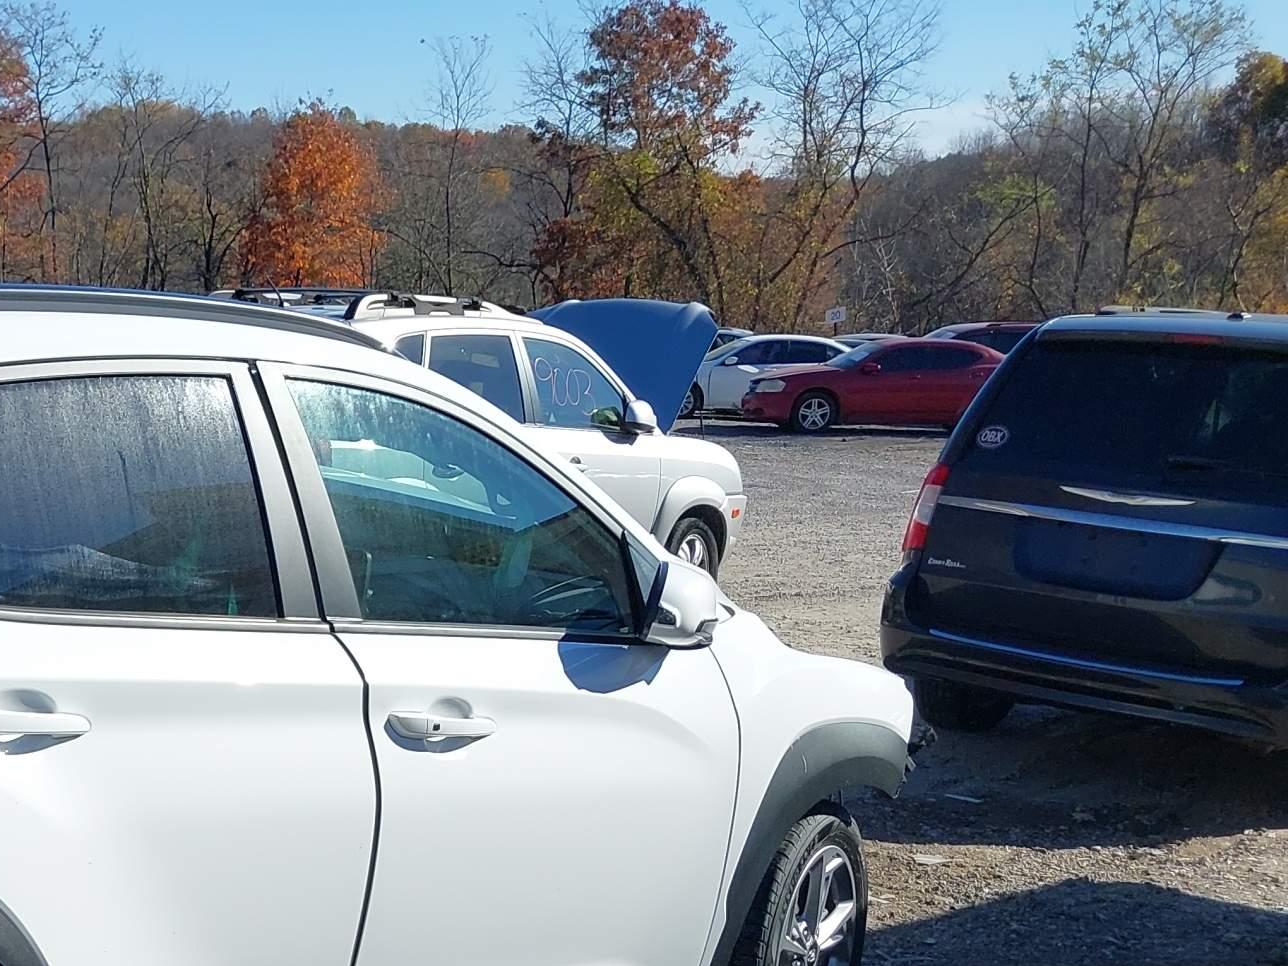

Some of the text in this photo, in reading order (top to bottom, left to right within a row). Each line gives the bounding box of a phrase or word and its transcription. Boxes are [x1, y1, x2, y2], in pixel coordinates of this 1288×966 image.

[830, 309, 841, 321] 20
[534, 356, 598, 416] 9003
[981, 430, 1004, 443] OBX
